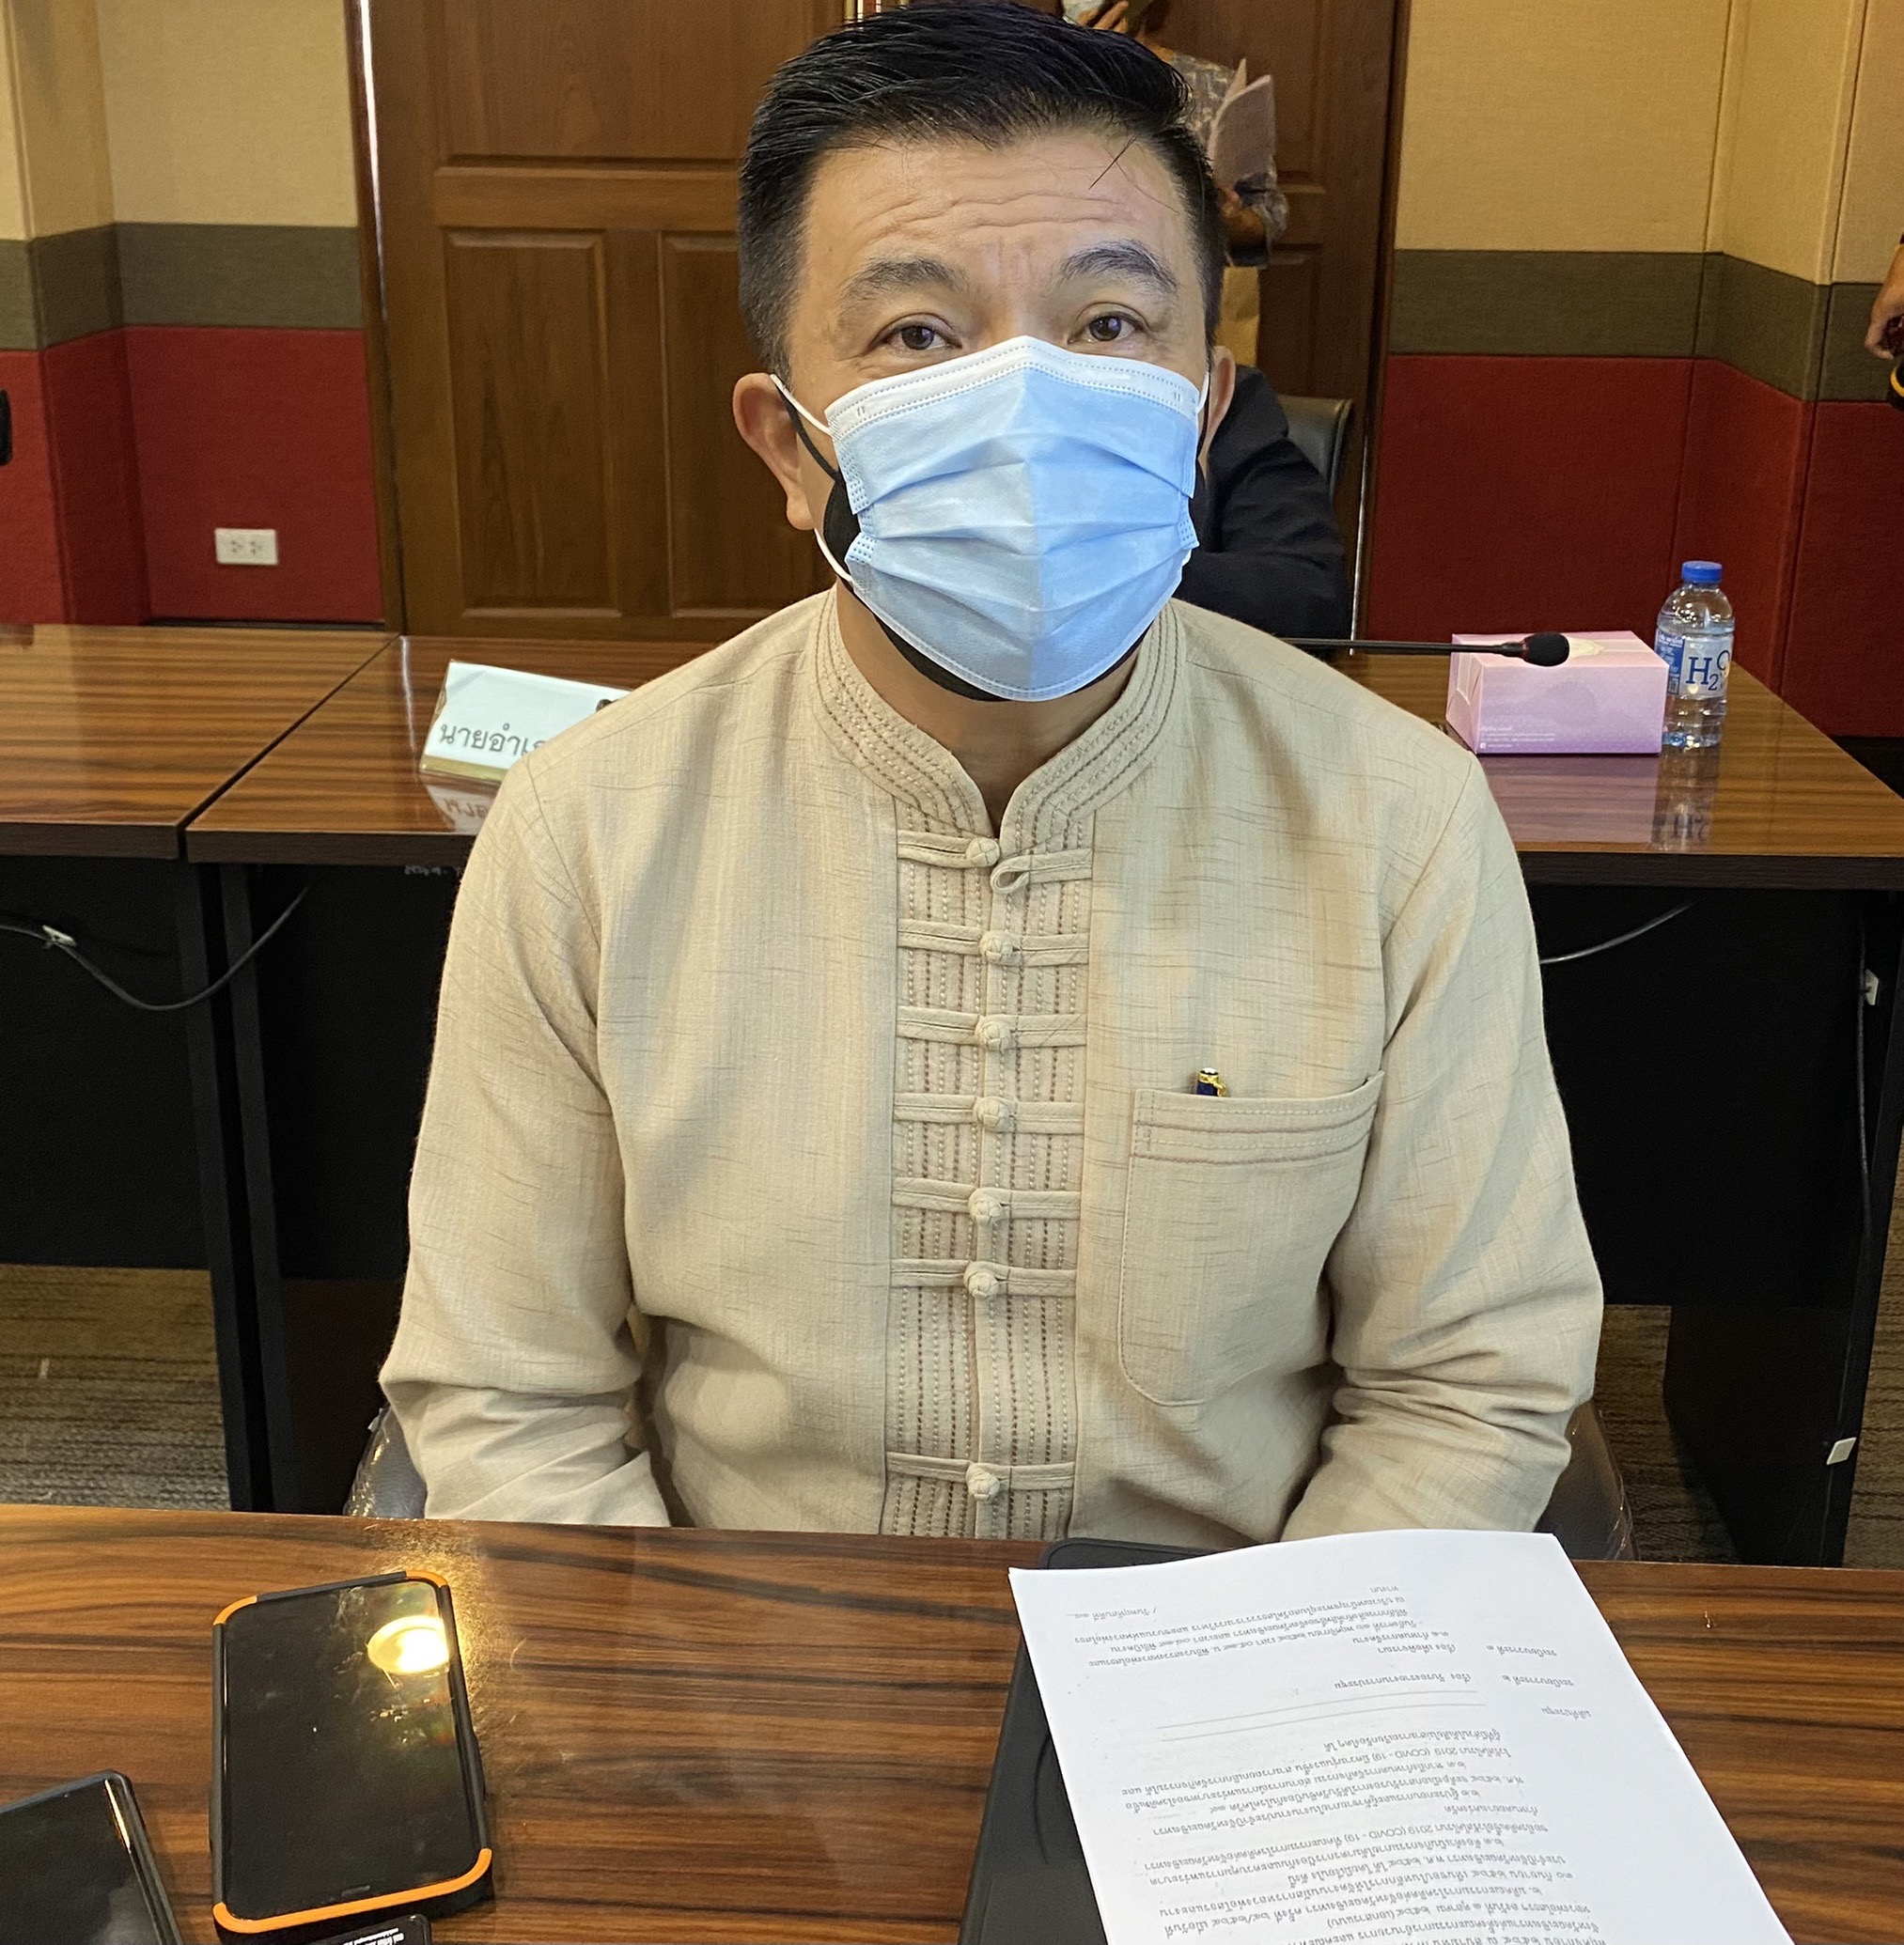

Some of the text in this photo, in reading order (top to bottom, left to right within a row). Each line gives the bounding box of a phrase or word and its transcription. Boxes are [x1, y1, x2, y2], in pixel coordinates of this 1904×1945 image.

[440, 723, 547, 756] นายอำเ
[1192, 1631, 1231, 1644] และเวลา
[1254, 1637, 1276, 1646] เวลา
[1351, 1631, 1429, 1644] กำหนดการจัดงาน
[1377, 1643, 1457, 1656] เรื่อง เพื่อพิจารณา
[1334, 1673, 1472, 1689] เรื่อง รับรองรายงานการประชุม
[1322, 1741, 1337, 1753] ได้
[1394, 1747, 1431, 1760] (COVID
[1433, 1747, 1459, 1757] 2019
[1458, 1746, 1512, 1758] ไวรัสโคโรนา
[1371, 1751, 1388, 1763] 19)
[1144, 1765, 1293, 1797] สามารถยกเลิกการจัดกิจกรรมได้
[1120, 1786, 1143, 1797] และ
[1367, 1825, 1407, 1842] (COVID
[1407, 1824, 1434, 1835] 2019
[1343, 1832, 1361, 1844] 19)
[1371, 1860, 1387, 1874] ได้
[1287, 1872, 1309, 1891] ดังนี้
[1507, 1869, 1553, 1883] กันยายน
[1303, 1885, 1528, 1916] มติคณะกรรมการโรคติดต่อจังหวัดฉะเชิงเทรา
[1435, 1900, 1473, 1914] ตุลาคม
[1272, 1906, 1303, 1924] ครั้งที่
[1483, 1902, 1520, 1918] ลงวันที่
[1163, 1920, 1210, 1940] เมื่อวันที่
